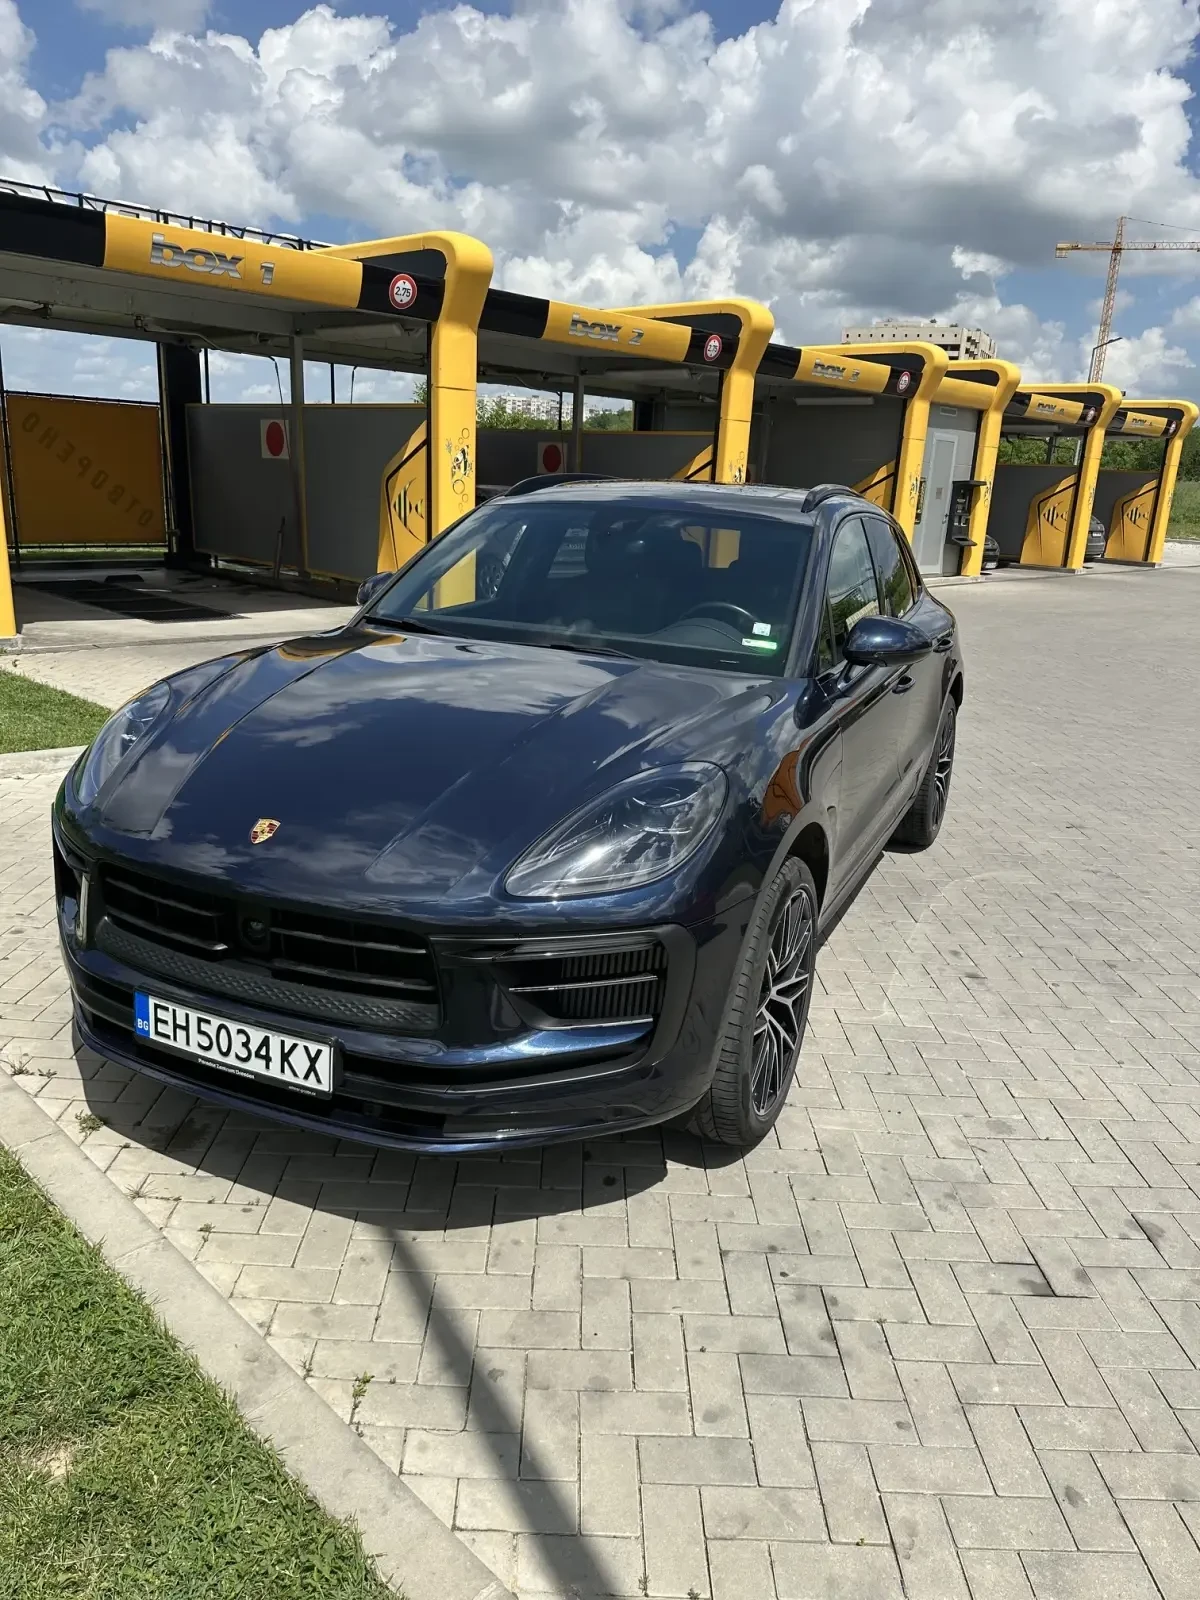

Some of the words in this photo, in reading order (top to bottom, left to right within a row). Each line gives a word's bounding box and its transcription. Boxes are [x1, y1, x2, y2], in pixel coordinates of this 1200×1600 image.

[150, 232, 245, 280] box
[260, 262, 276, 285] 1
[395, 286, 411, 298] 2.75
[568, 312, 623, 342] box
[628, 328, 645, 346] 2
[137, 1018, 149, 1031] BG
